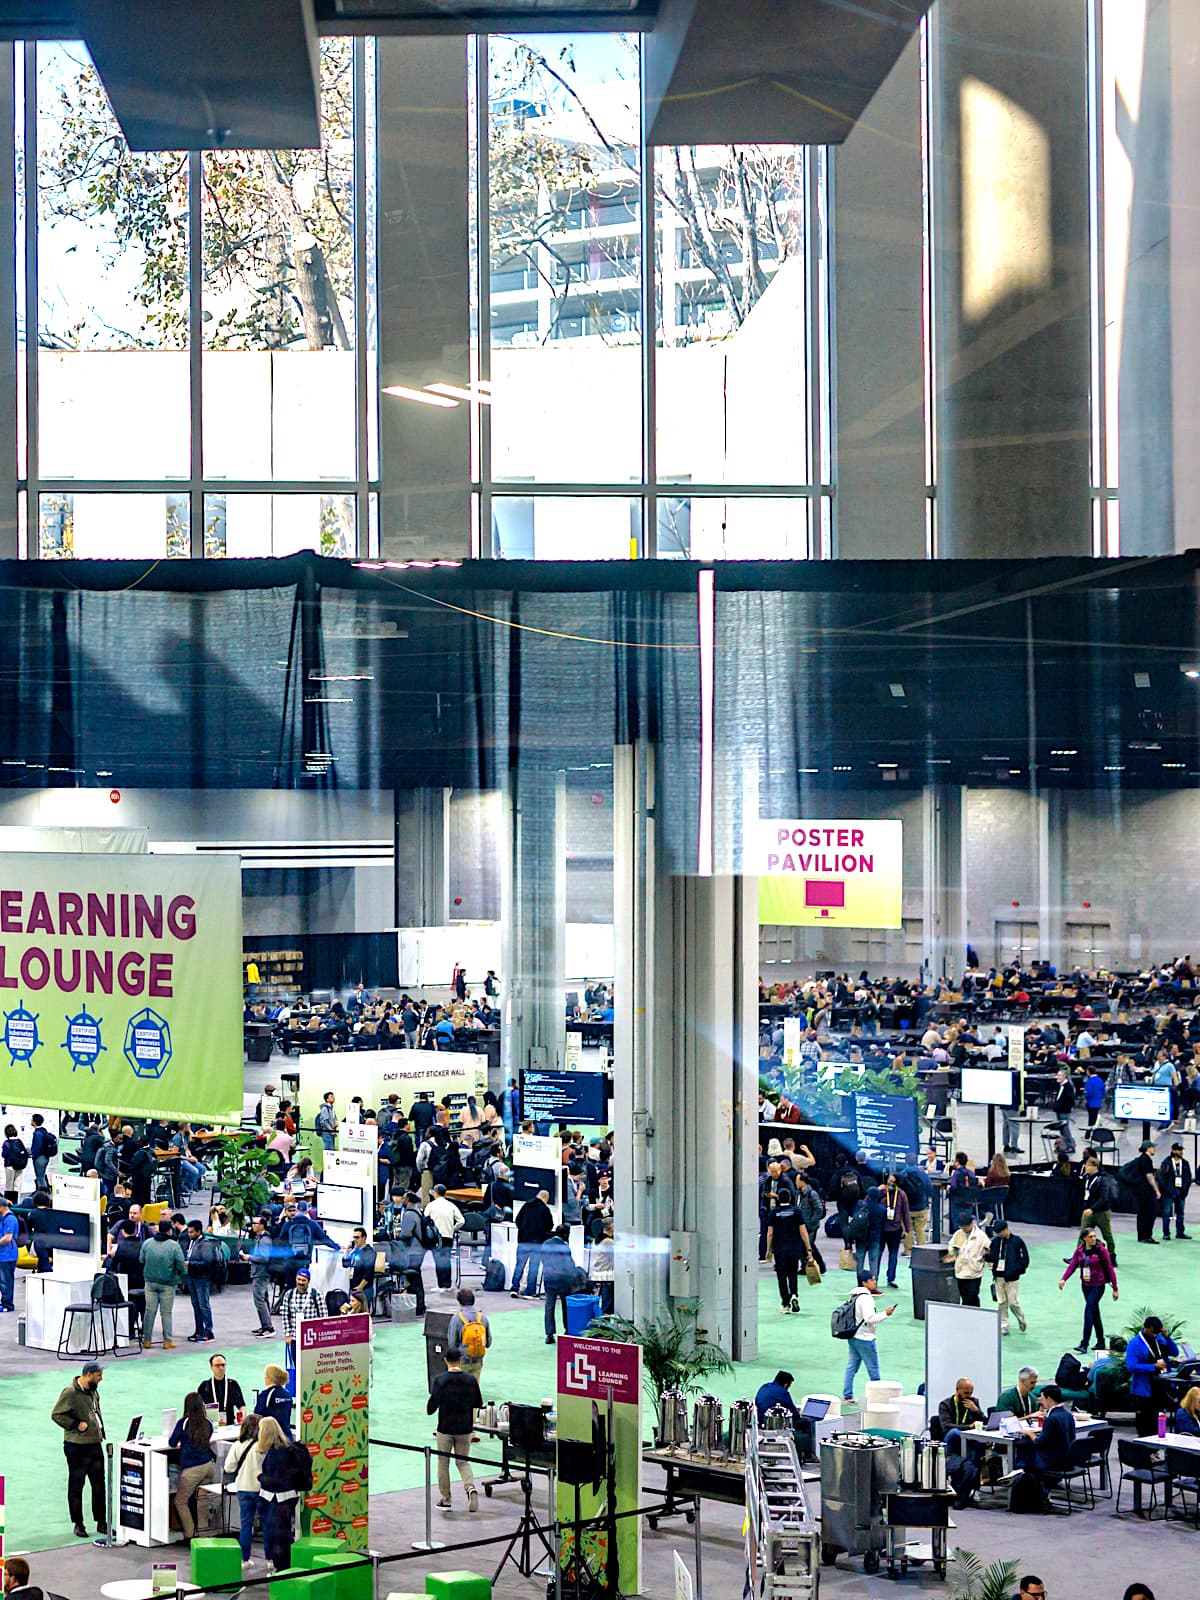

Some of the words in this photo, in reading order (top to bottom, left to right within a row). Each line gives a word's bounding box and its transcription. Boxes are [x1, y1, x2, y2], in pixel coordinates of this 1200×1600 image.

[777, 828, 864, 847] POSTER
[767, 854, 874, 872] PAVILION
[10, 1021, 32, 1029] CERTIFIED
[72, 1027, 95, 1035] CERTIFIED
[71, 1035, 96, 1043] kubernetes
[135, 1039, 160, 1047] kubernetes
[399, 1071, 425, 1079] PROJECT
[426, 1070, 450, 1078] STICKER
[450, 1068, 466, 1076] WALL
[573, 1343, 600, 1352] WELCOME
[317, 1359, 336, 1367] Diverse
[315, 1366, 334, 1375] Lasting
[335, 1364, 355, 1372] Growth.
[598, 1371, 628, 1380] LEARNING
[598, 1377, 623, 1385] LOUNGE
